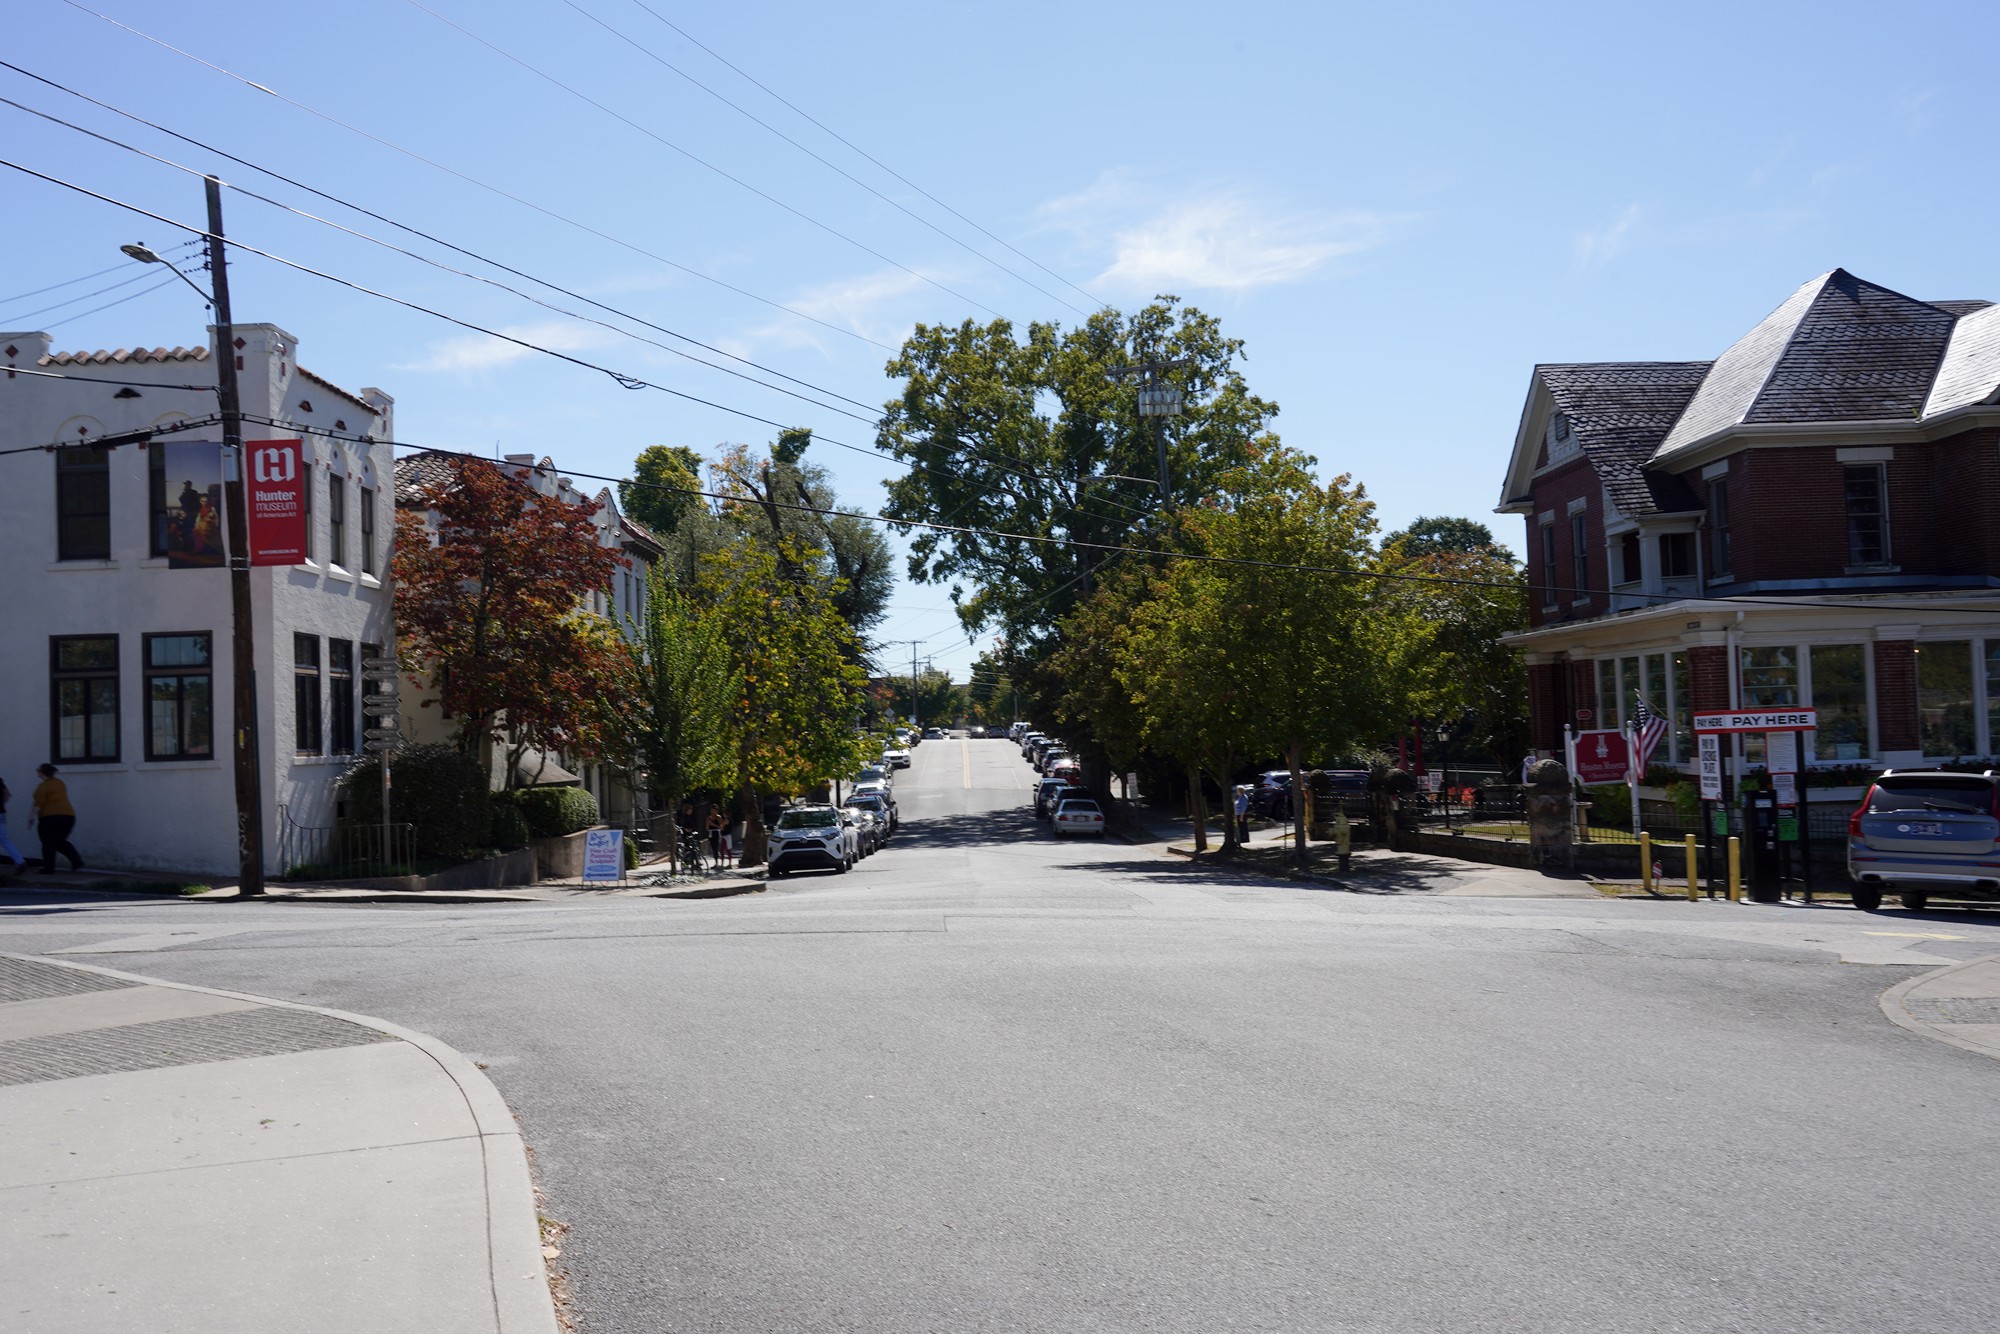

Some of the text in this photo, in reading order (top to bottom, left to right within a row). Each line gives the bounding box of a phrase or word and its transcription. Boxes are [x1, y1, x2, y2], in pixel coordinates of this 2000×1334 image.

[256, 491, 296, 501] Hunter
[1696, 714, 1808, 727] PAY HERE PAY HERE
